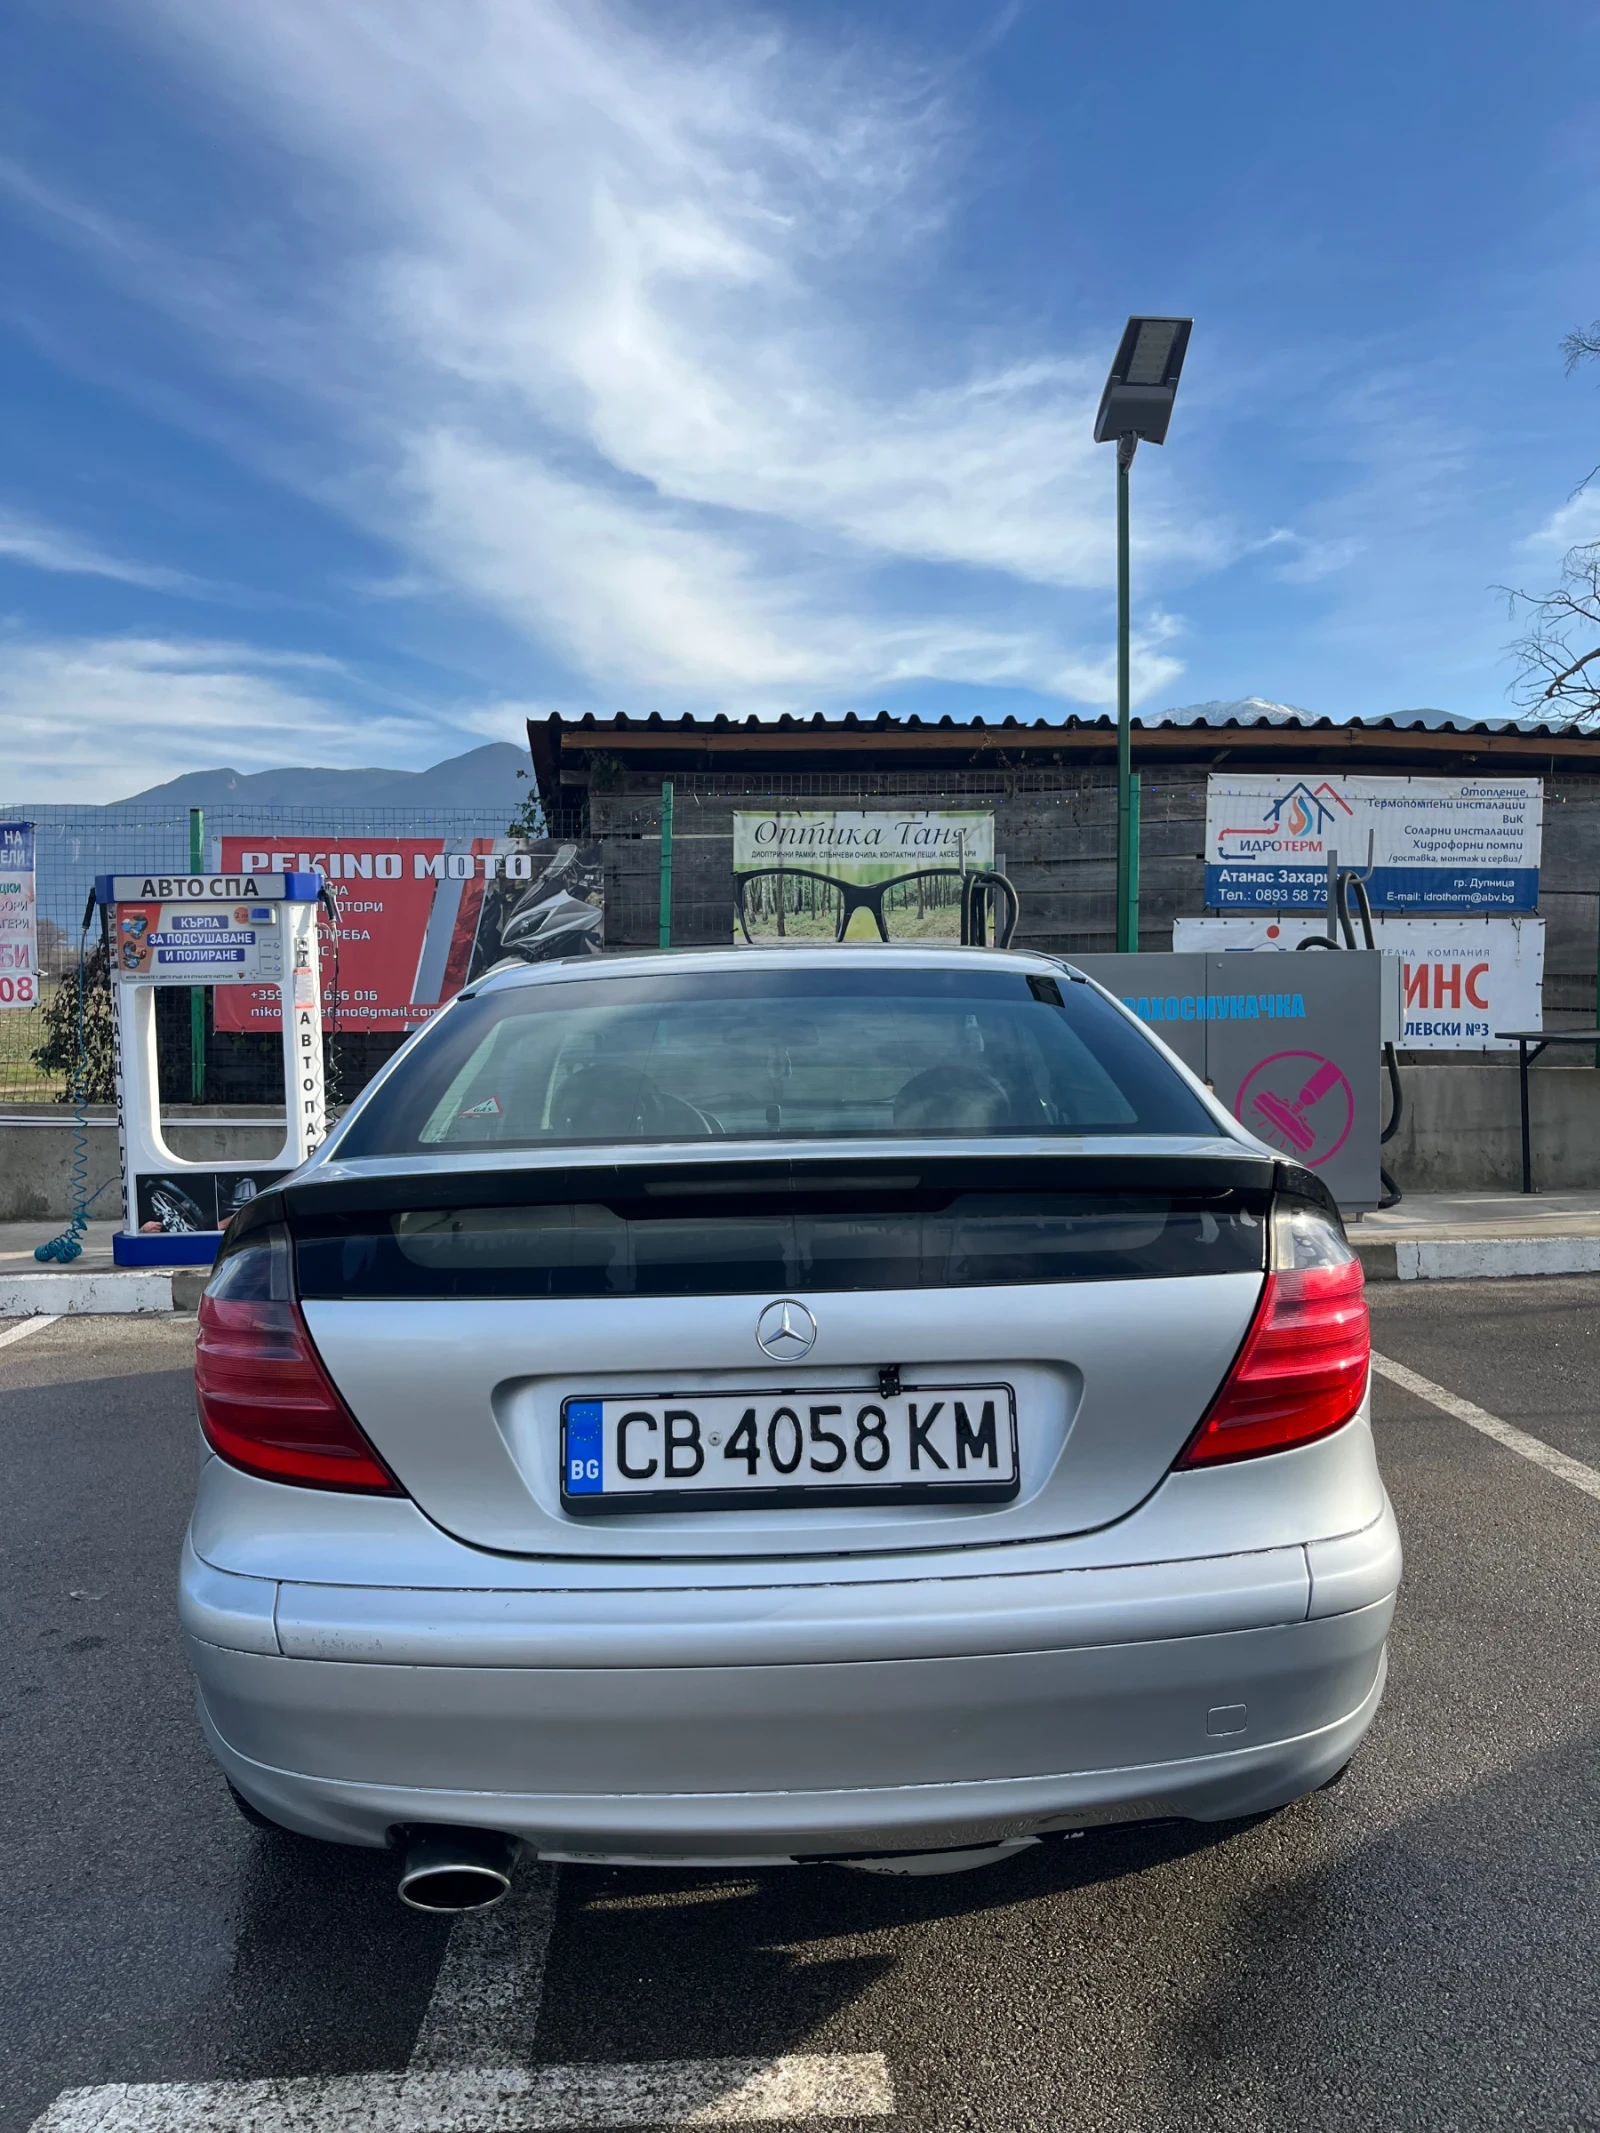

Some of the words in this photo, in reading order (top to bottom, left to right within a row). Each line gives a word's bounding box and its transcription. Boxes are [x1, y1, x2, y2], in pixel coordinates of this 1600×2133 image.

[1456, 801, 1526, 811] инсталации
[1502, 814, 1524, 824] ВиК
[4, 830, 23, 845] НА
[754, 820, 884, 845] Оптика
[894, 821, 969, 845] Таня
[1404, 825, 1451, 838] Соларни
[1454, 827, 1524, 837] инсталации
[1240, 840, 1322, 852] ИДРОТЕРМ
[1412, 839, 1483, 852] Хидрофорни
[1486, 842, 1523, 850] помпи
[751, 850, 794, 859] ДИОПТРИЧНИ
[880, 851, 916, 859] КОНТАКТНИ
[939, 850, 976, 858] АКСЕСАРИ
[1440, 855, 1479, 863] монтаж
[413, 853, 533, 880] MOTO
[1218, 869, 1274, 883] Атанас
[140, 878, 204, 897] АВТО
[209, 878, 260, 897] СПА
[1453, 879, 1468, 888] гр.
[1469, 879, 1515, 889] Дупница
[1218, 888, 1251, 901] Тел.:
[1255, 889, 1288, 901] 0893
[1292, 889, 1309, 901] 58
[1387, 892, 1421, 901] E-mail:
[1423, 892, 1515, 903] idrotherm@abv.bg
[181, 916, 220, 928] КЪРПА
[149, 933, 164, 945] ЗА
[167, 932, 252, 946] ПОДСУШАВАНЕ
[165, 950, 174, 961] И
[176, 949, 237, 961] ПОЛИРАНЕ
[1427, 948, 1490, 957] КОМПАНИЯ
[1403, 962, 1489, 1009] ИНС
[354, 989, 378, 1001] 016
[1119, 993, 1306, 1022] РАХОСМУКАЧКА
[1465, 1022, 1489, 1036] №3
[616, 1409, 705, 1480] CB
[724, 1404, 890, 1476] 4058
[908, 1400, 999, 1470] KM
[570, 1459, 600, 1480] BG
